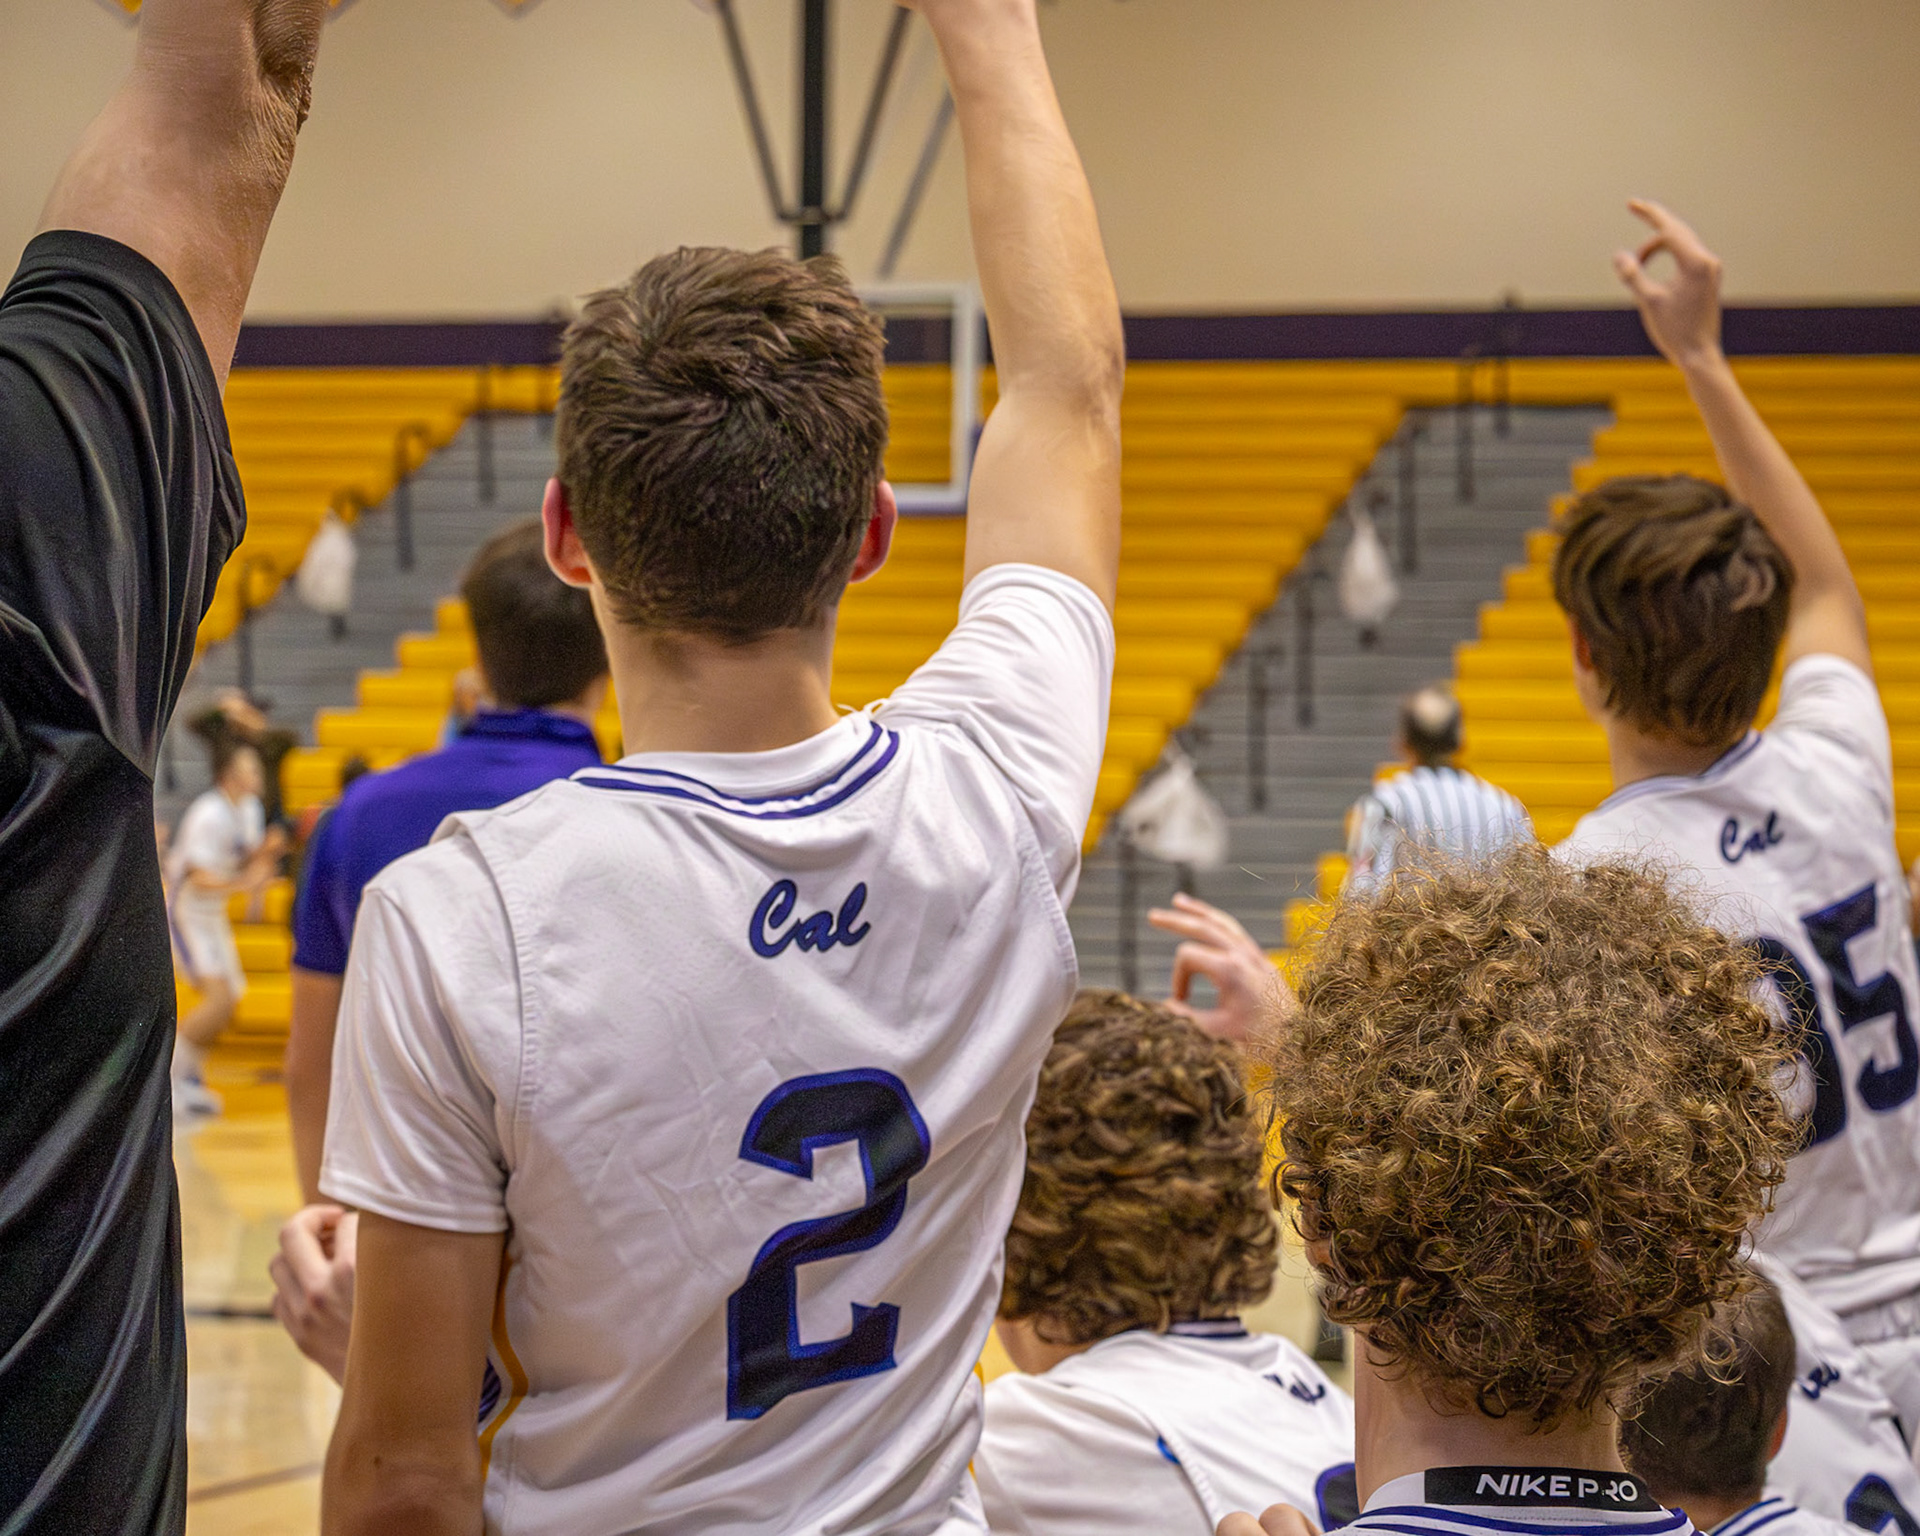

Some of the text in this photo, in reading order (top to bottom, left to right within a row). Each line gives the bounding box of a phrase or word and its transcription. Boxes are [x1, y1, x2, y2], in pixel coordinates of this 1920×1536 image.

[1720, 809, 1783, 865] Cal
[748, 878, 872, 959] Cal
[726, 1066, 932, 1422] 2
[1475, 1472, 1639, 1503] NIKE PRO
